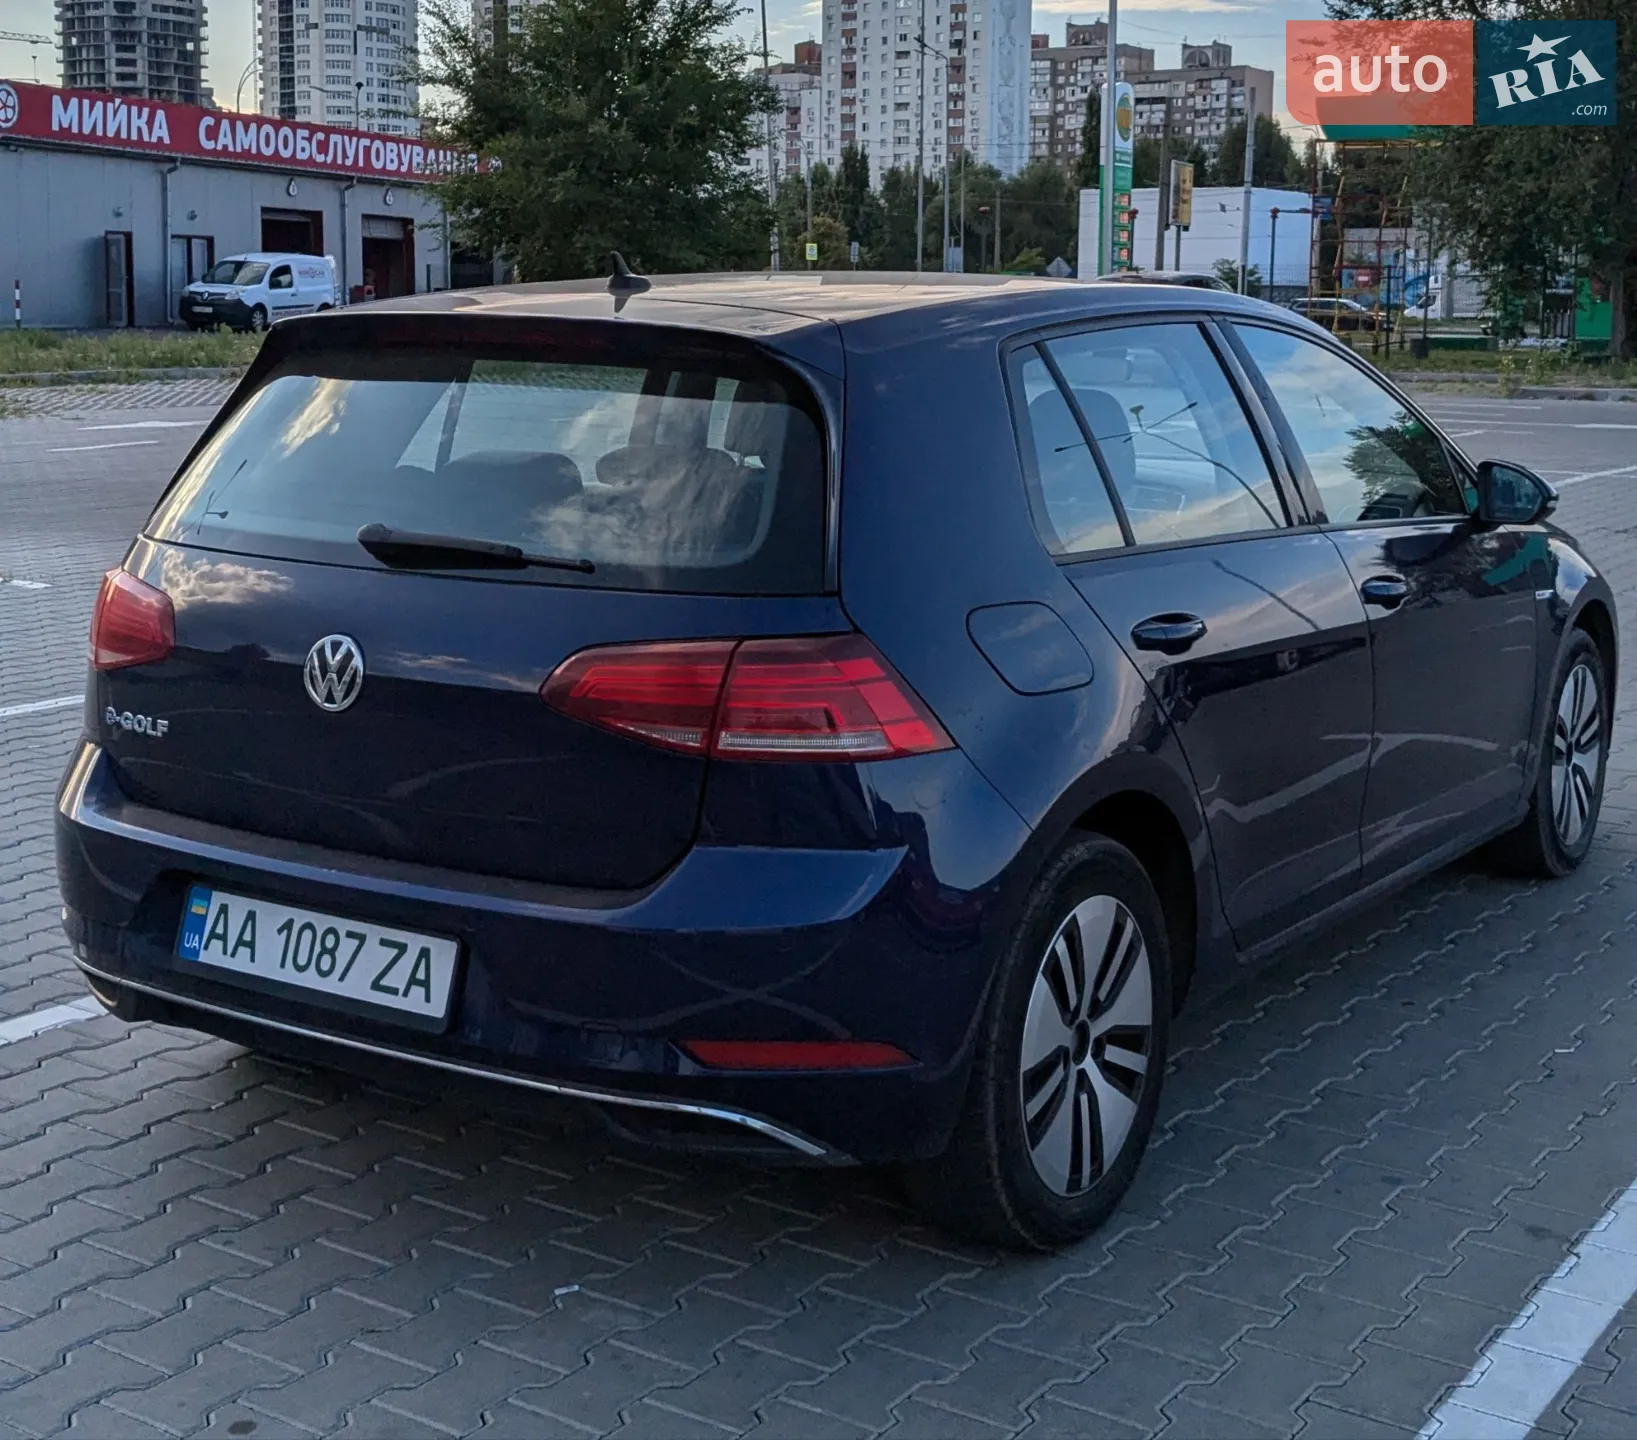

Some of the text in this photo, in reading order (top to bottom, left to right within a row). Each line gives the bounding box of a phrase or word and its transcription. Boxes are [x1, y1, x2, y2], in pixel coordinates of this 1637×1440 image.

[51, 94, 171, 145] МИЙКА
[184, 931, 200, 951] UA
[203, 902, 432, 1004] AA 1087 ZA
